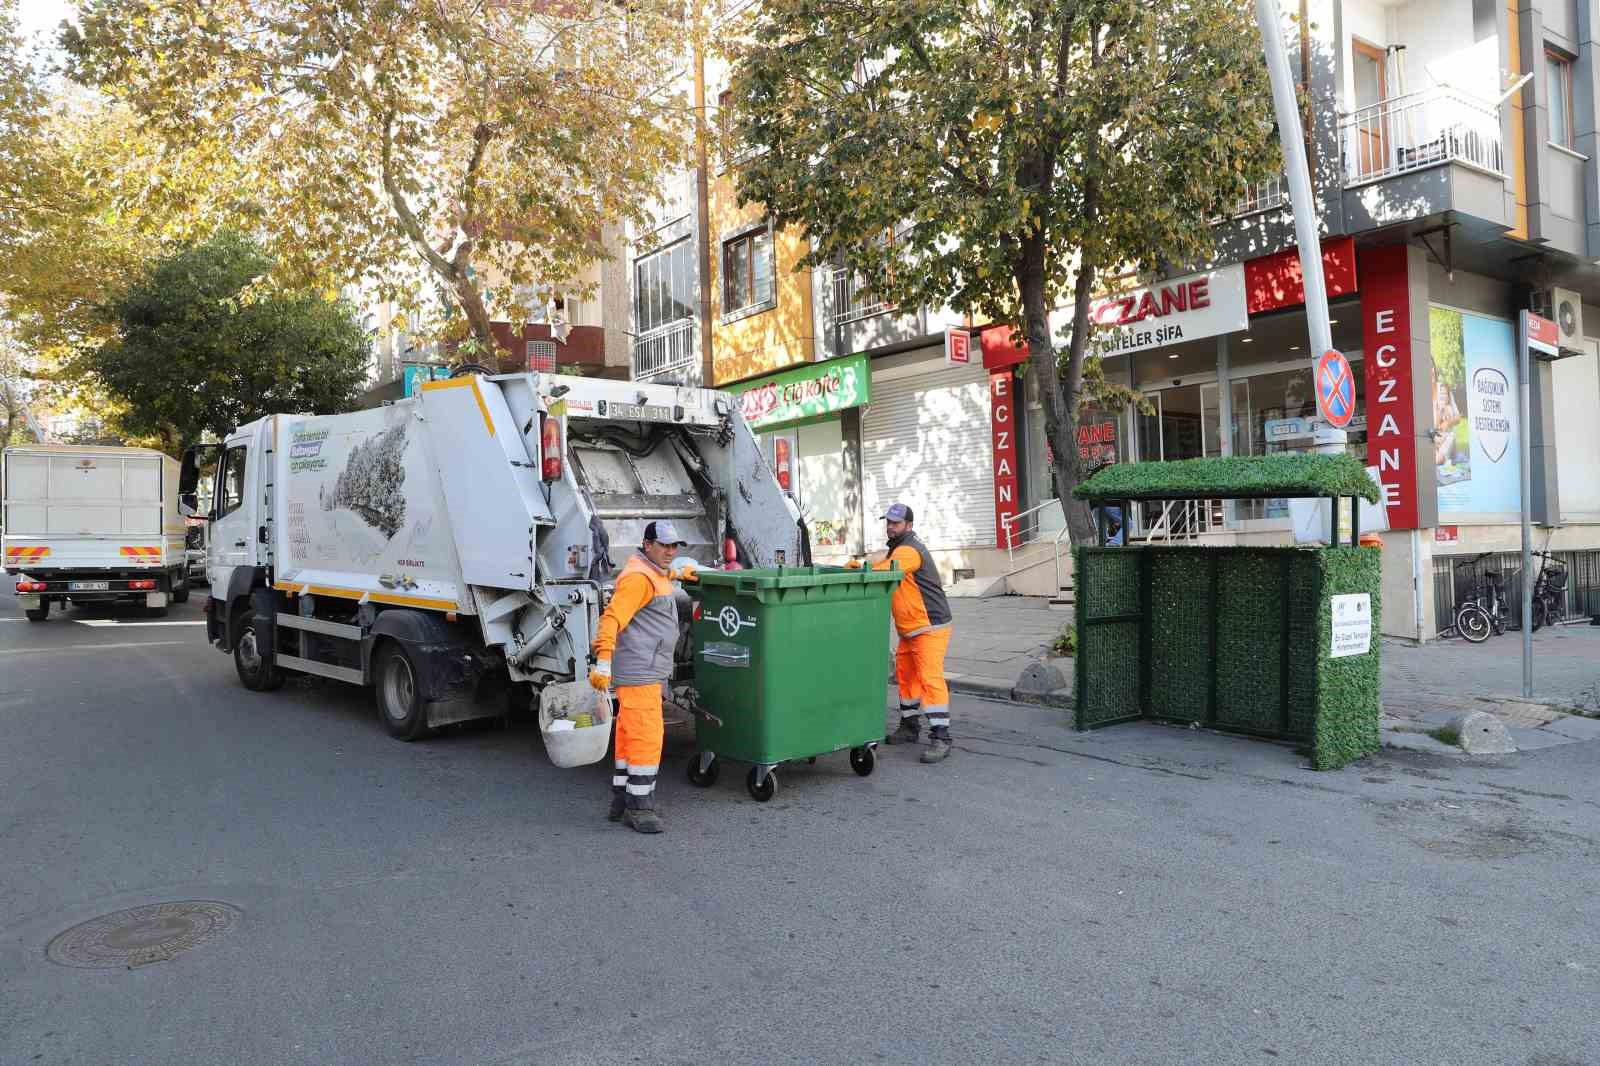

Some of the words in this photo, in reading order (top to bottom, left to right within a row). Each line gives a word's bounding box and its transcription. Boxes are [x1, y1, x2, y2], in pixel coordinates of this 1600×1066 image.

[1089, 276, 1211, 326] CZANE
[1156, 323, 1183, 347] ŞİFA
[994, 378, 1012, 530] ECZANE
[1375, 309, 1401, 507] ECZANE
